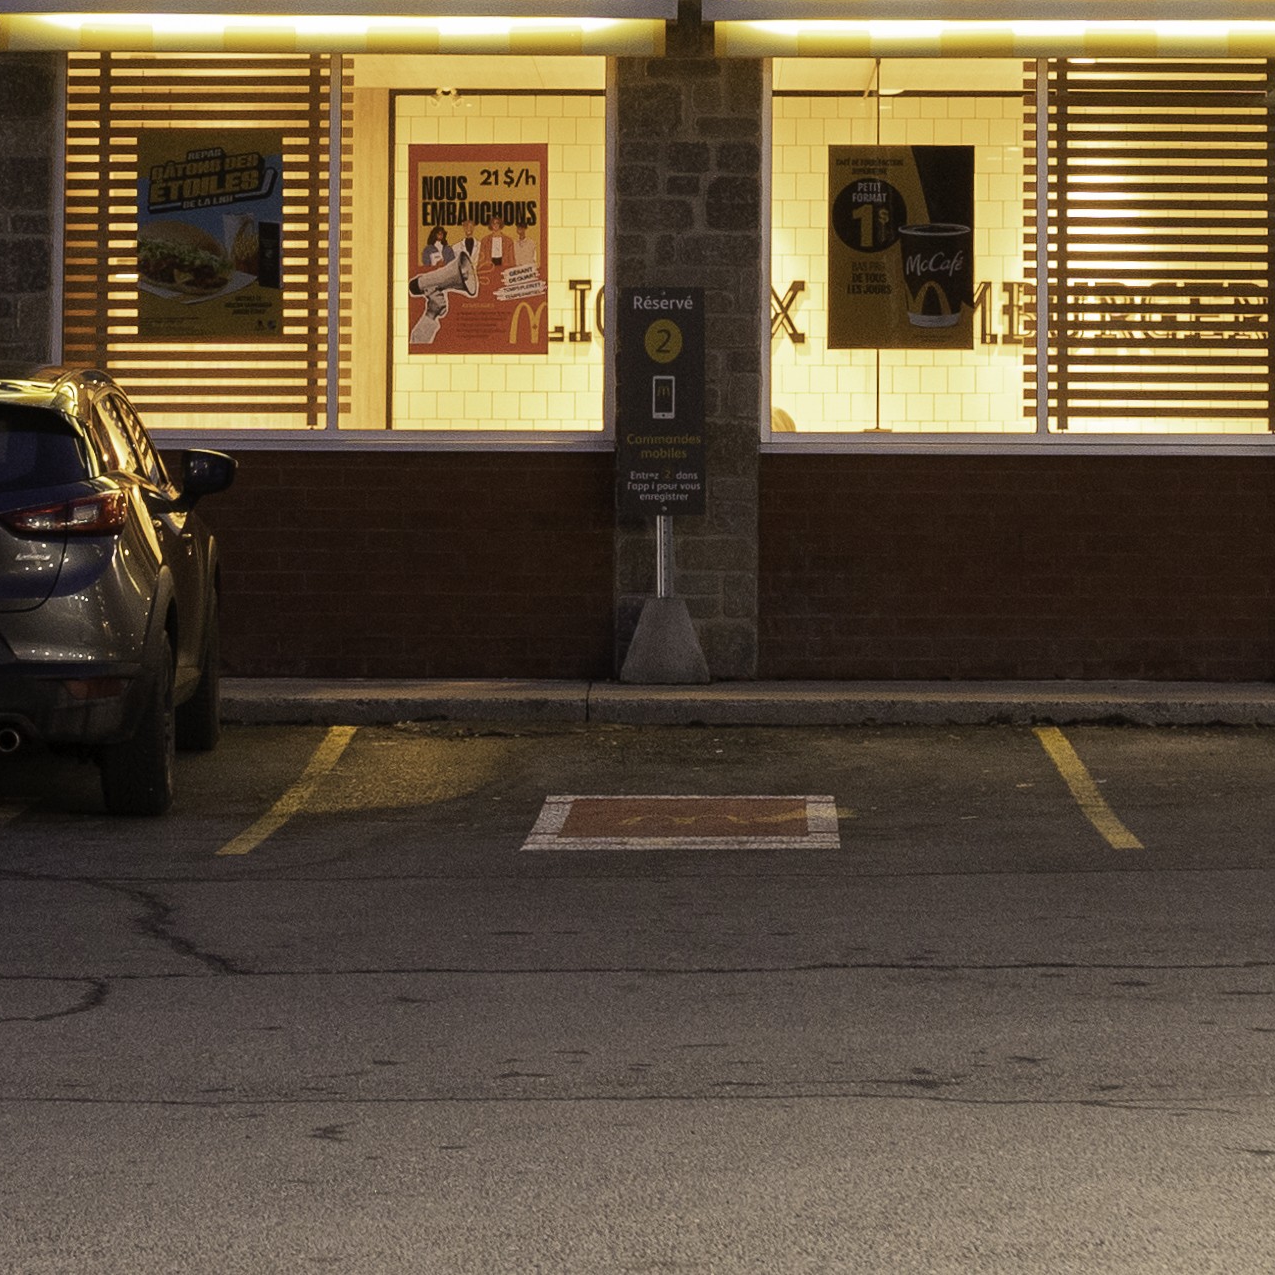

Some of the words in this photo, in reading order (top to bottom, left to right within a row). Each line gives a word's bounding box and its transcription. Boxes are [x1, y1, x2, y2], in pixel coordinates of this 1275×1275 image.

[480, 169, 499, 185] 21
[503, 167, 537, 188] $/h
[149, 169, 259, 203] ÉTOILES
[422, 175, 468, 201] NOUS
[857, 181, 881, 193] PETIT
[852, 193, 887, 203] FORMAT
[422, 201, 537, 227] EMBAUCHONS
[906, 250, 963, 276] McCafé
[633, 295, 693, 310] Réservé
[656, 328, 671, 353] 2
[627, 433, 701, 444] Commandes
[641, 447, 687, 458] mobiles
[630, 470, 659, 480] Entrez
[676, 470, 699, 480] dans
[656, 483, 677, 492] pour
[639, 491, 689, 502] enregistrer
